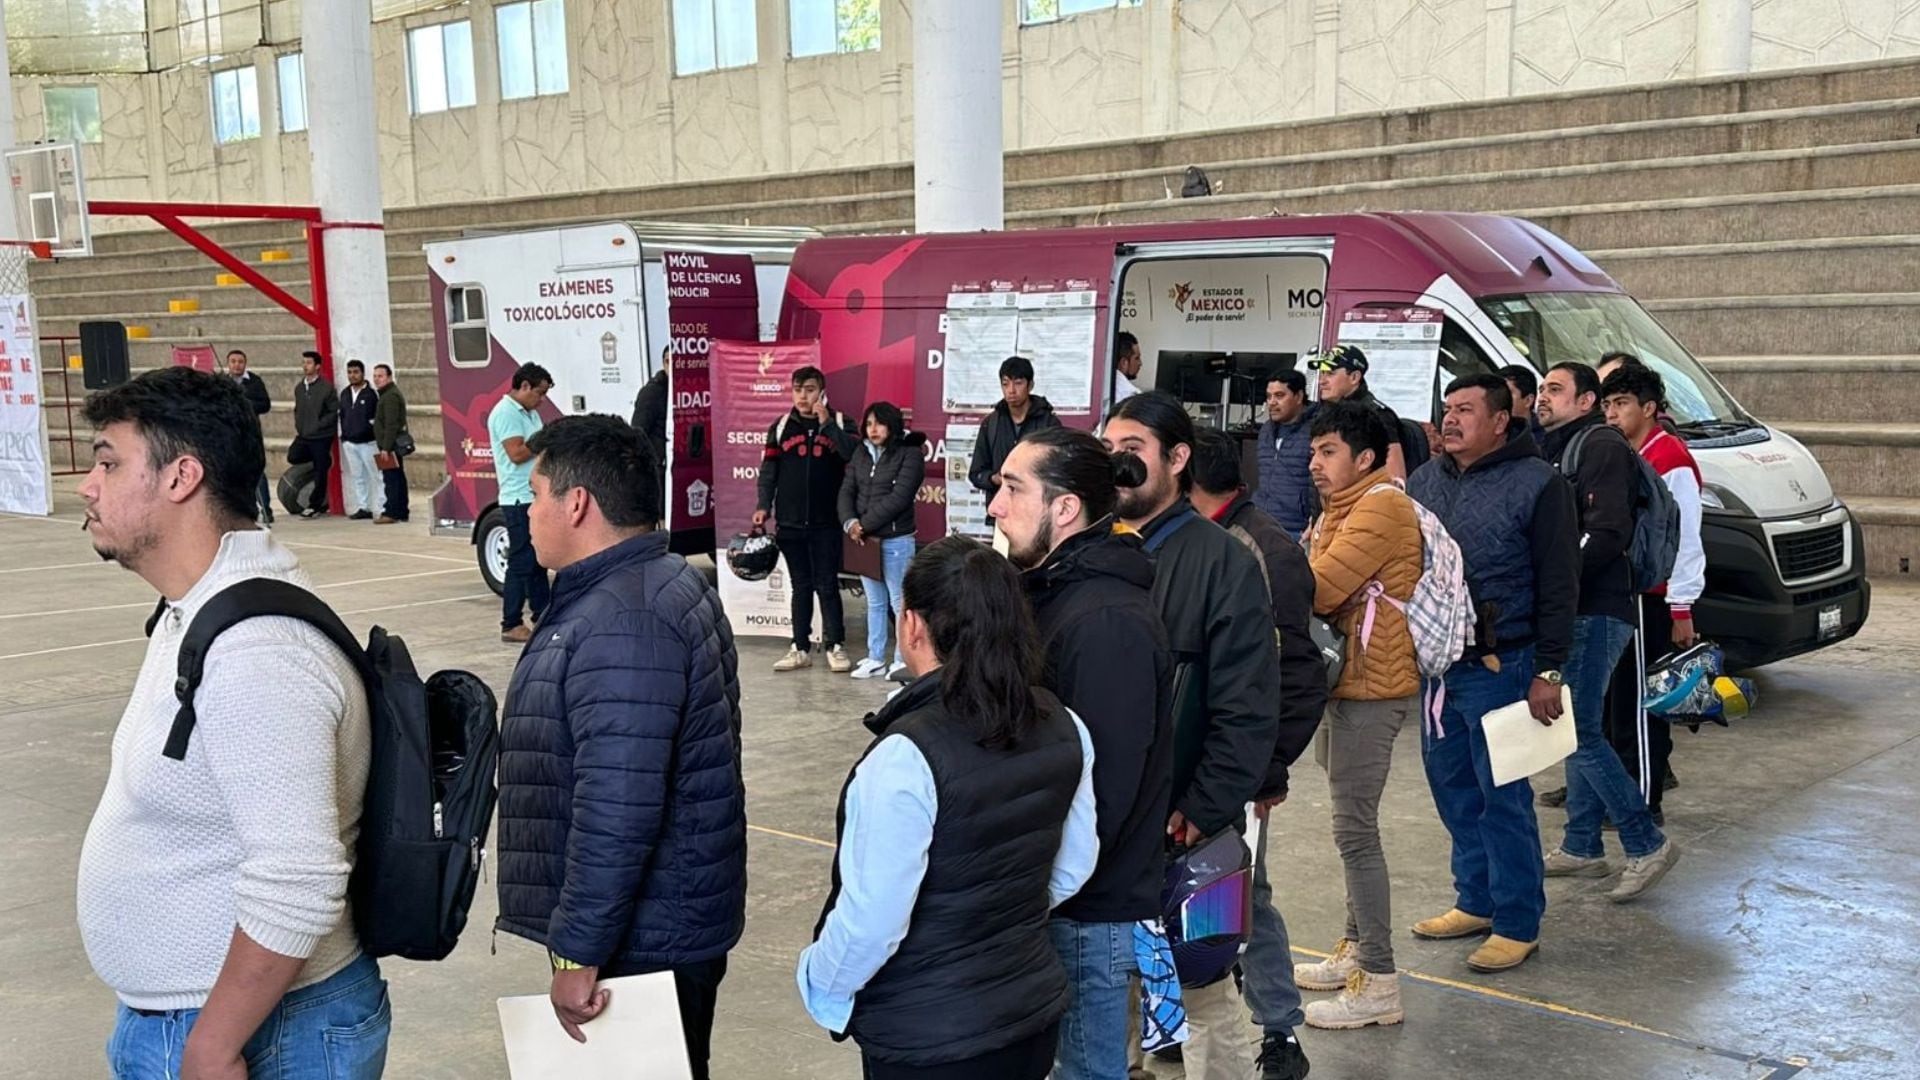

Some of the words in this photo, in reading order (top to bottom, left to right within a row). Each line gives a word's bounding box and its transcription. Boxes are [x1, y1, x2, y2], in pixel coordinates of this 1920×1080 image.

[668, 253, 709, 269] MÓVIL
[670, 271, 686, 283] DE
[687, 272, 742, 285] LICENCIAS
[539, 277, 615, 298] EXÁMENES
[1202, 288, 1233, 297] ESTADO
[1233, 287, 1244, 296] DE
[503, 301, 617, 322] TOXICOLÓGICOS
